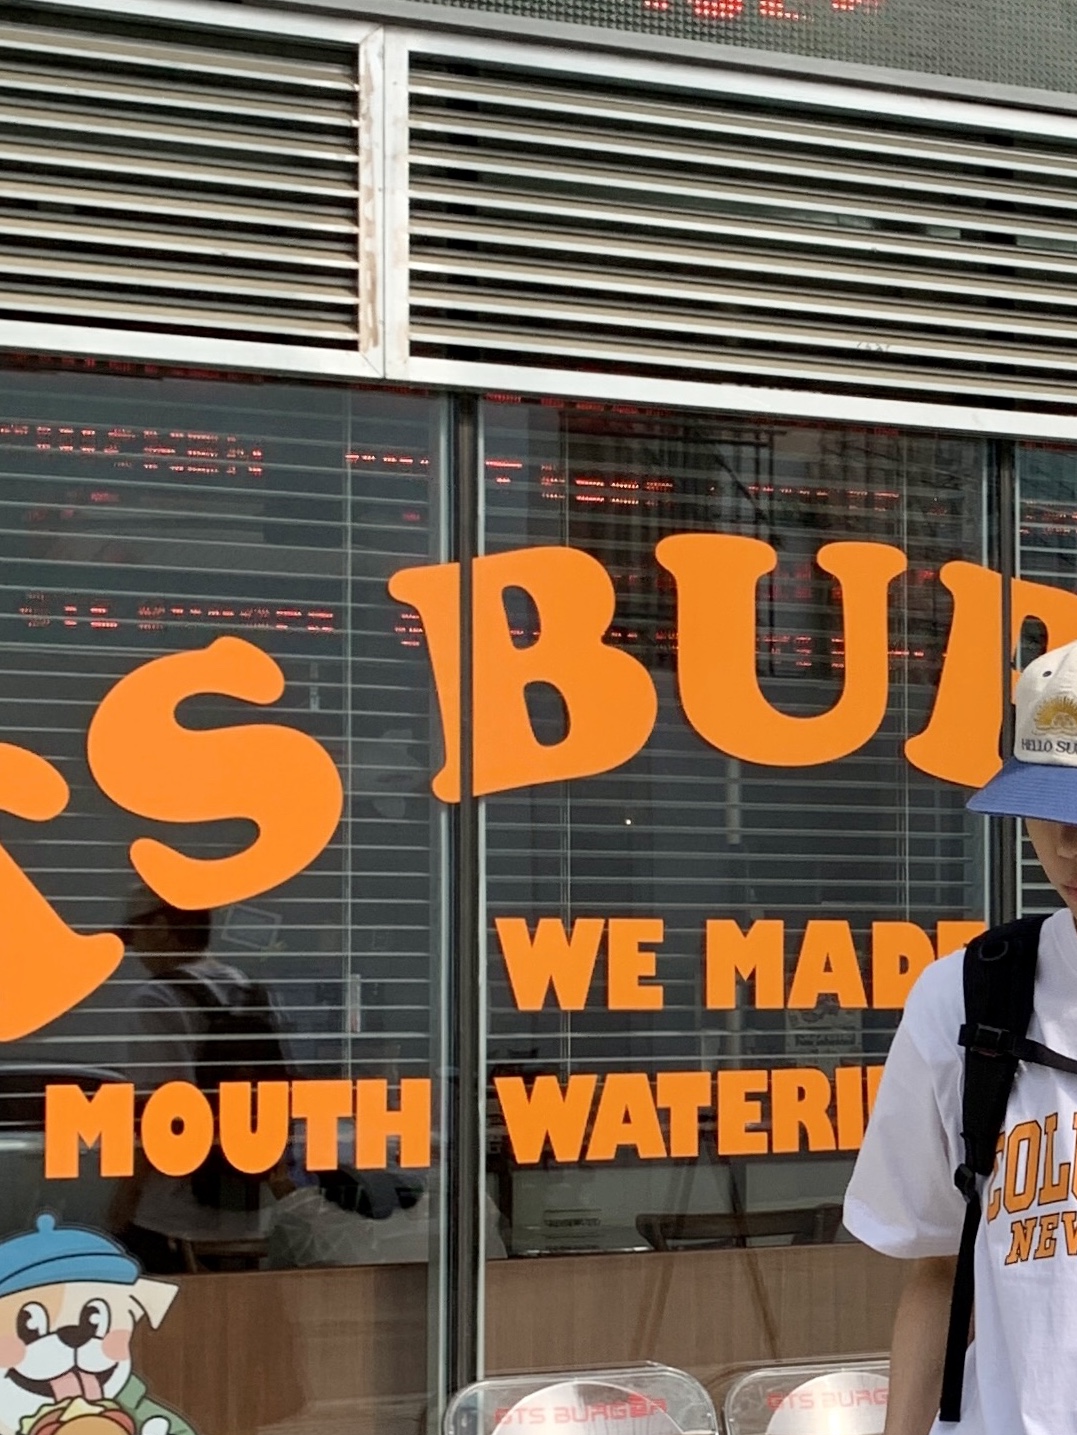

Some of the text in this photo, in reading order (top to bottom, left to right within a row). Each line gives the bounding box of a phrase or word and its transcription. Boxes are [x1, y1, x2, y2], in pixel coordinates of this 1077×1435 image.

[1021, 738, 1053, 752] HELLO
[496, 918, 664, 1010] WE
[45, 1065, 886, 1178] MOUTH WATERI
[766, 1390, 813, 1411] GTS
